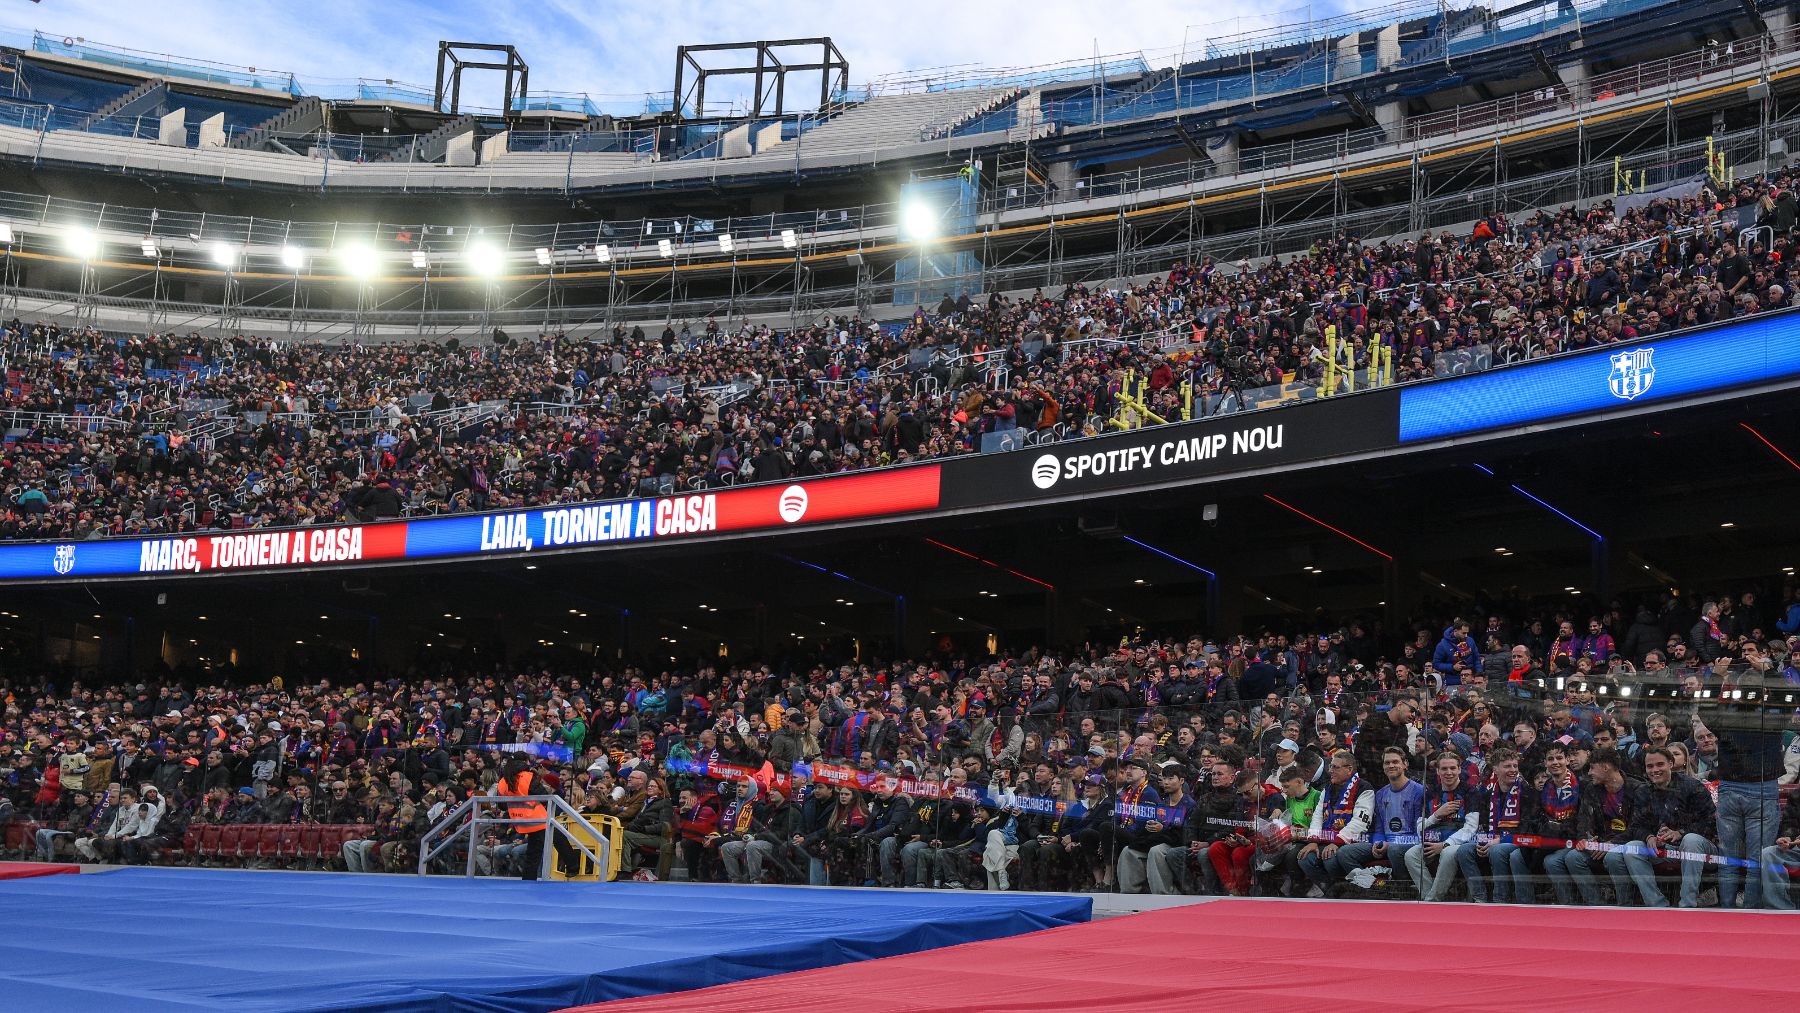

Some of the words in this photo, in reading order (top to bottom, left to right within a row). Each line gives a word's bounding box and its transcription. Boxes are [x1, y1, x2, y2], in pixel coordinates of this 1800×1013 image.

[1064, 445, 1155, 480] SPOTIFY
[1160, 434, 1227, 465] CAMP
[1232, 425, 1283, 455] NOU
[140, 540, 201, 573] MARC,
[211, 533, 290, 568] TORNEM
[292, 532, 306, 563] A
[309, 527, 363, 562] CASA
[481, 514, 532, 553] LAIA,
[543, 503, 632, 547] TORNEM
[635, 504, 651, 537] A
[655, 494, 717, 536] CASA
